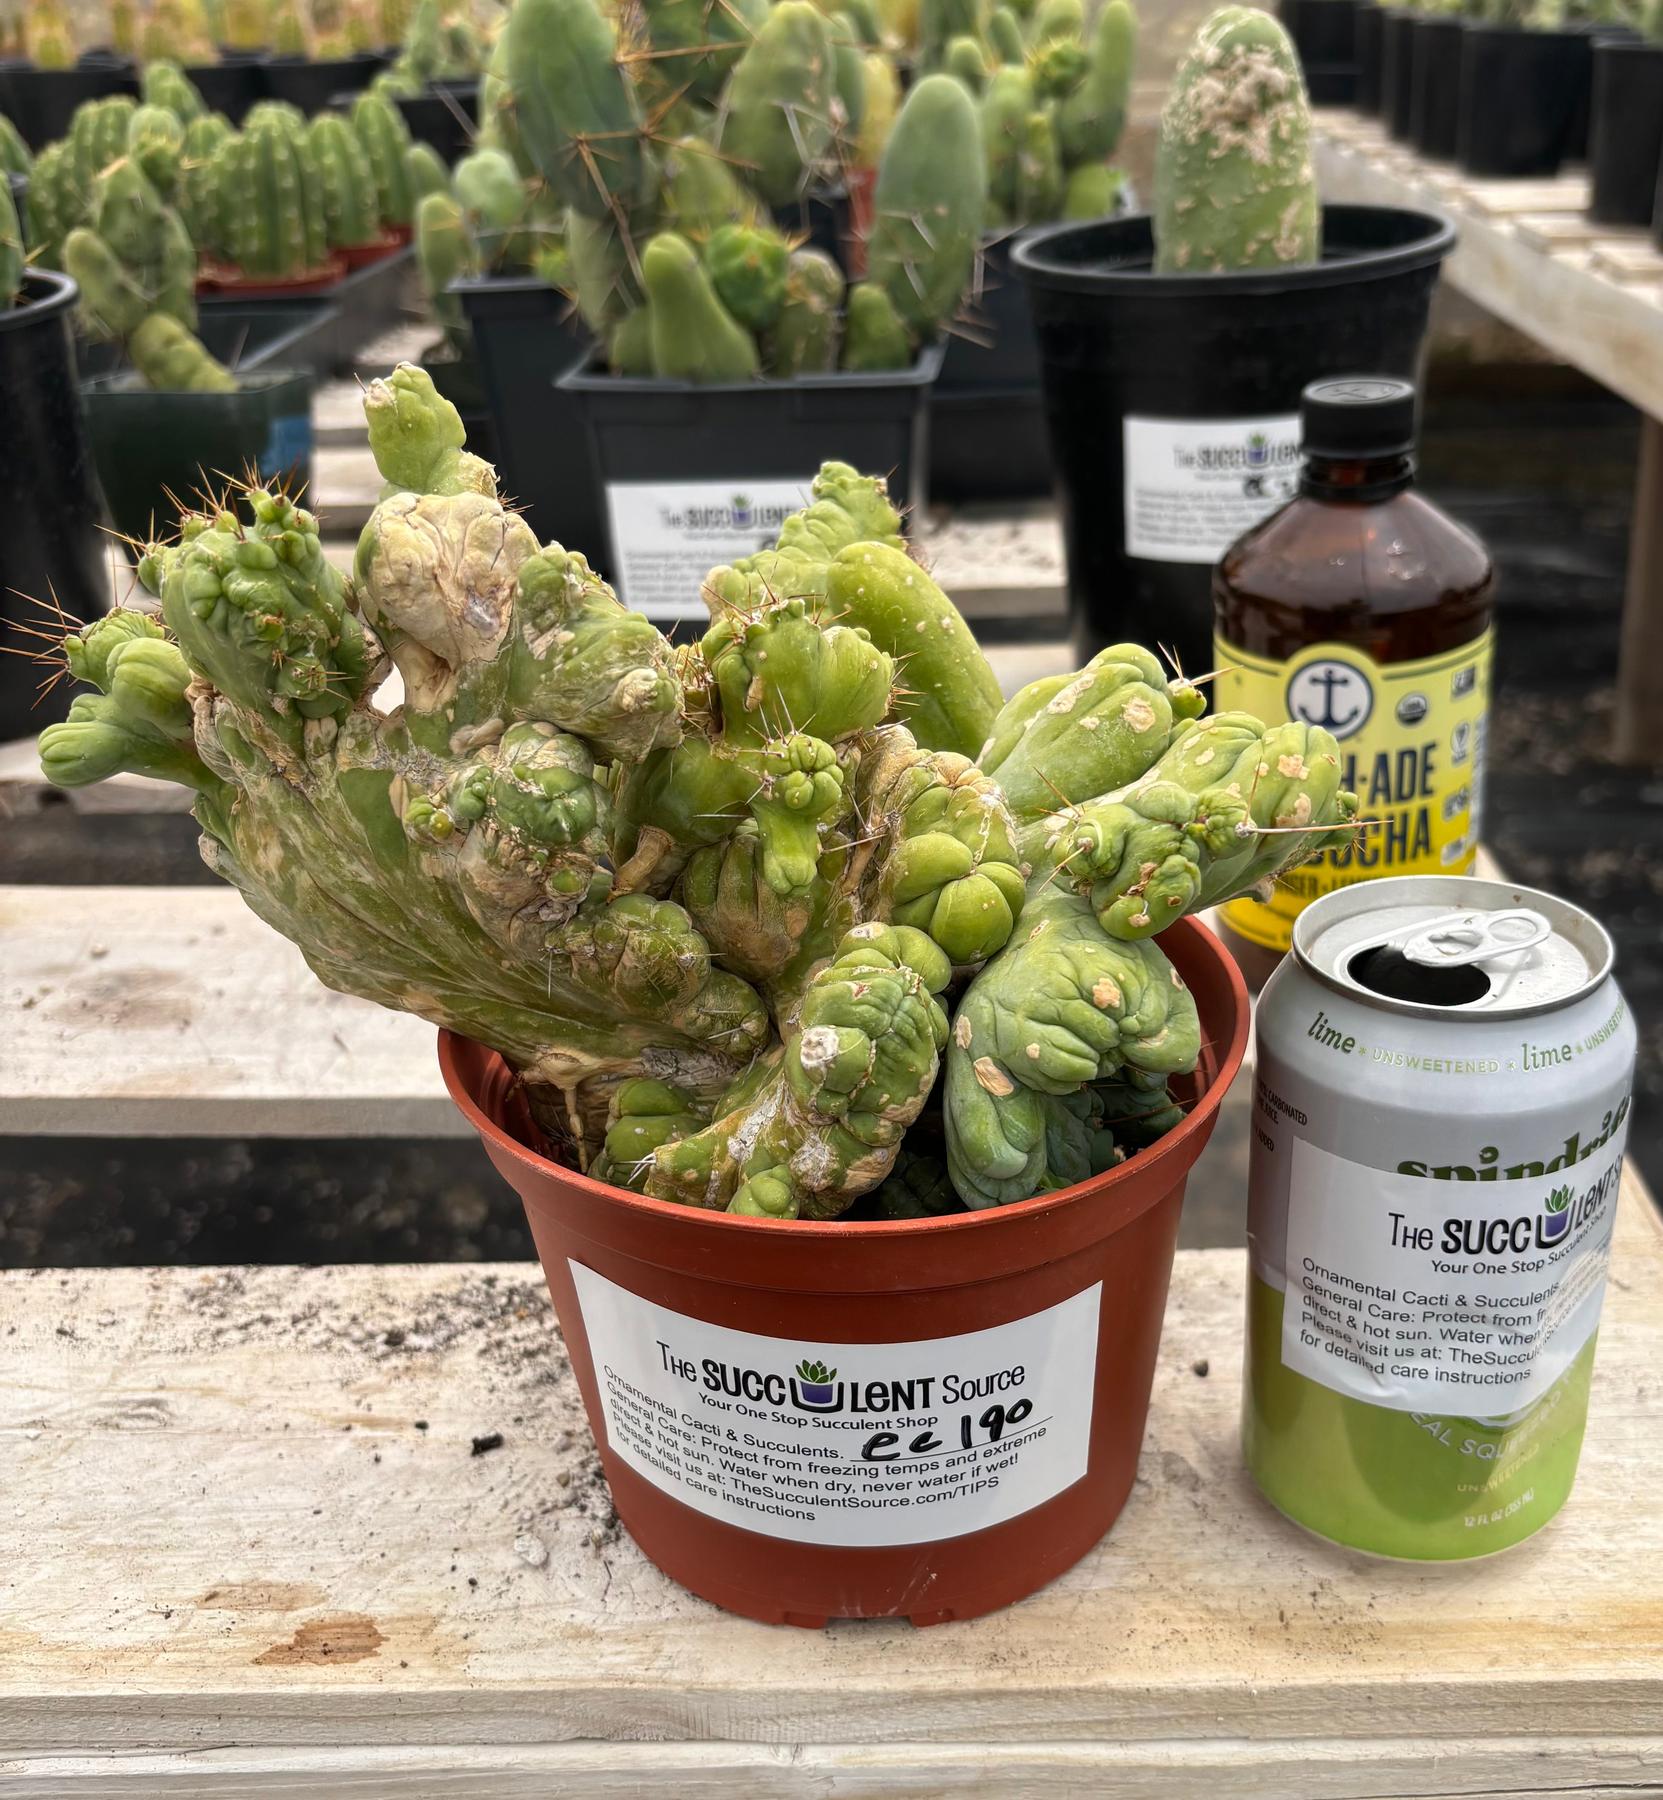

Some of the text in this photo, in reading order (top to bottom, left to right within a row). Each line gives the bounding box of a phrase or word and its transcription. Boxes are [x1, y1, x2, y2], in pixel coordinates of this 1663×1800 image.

[1307, 1012, 1356, 1054] lime
[1372, 1047, 1500, 1074] UNSWEETENED
[1521, 1043, 1573, 1071] lime
[1268, 1089, 1308, 1126] CARBONATED
[1302, 1257, 1396, 1302] Ornamental
[1402, 1290, 1449, 1307] Cacti
[1455, 1294, 1468, 1307] &
[1431, 1259, 1469, 1274] Your
[1473, 1262, 1507, 1275] One
[1511, 1258, 1545, 1274] Stop
[1302, 1276, 1362, 1312] General
[1368, 1303, 1416, 1323] Care:
[1422, 1311, 1486, 1325] Protect
[1493, 1313, 1532, 1327] from
[1303, 1294, 1541, 1345] direct & hot sun. Water when
[1300, 1328, 1531, 1386] for detailed care instructions
[1301, 1311, 1352, 1343] Please
[1356, 1340, 1389, 1357] visit
[1394, 1347, 1415, 1357] us
[1420, 1346, 1442, 1360] at:
[942, 1365, 1025, 1404] Source
[603, 1365, 844, 1459] Ornamental Cacti & Succulents.
[607, 1380, 1047, 1479] General Care: Protect from freezing temps and extreme
[698, 1392, 939, 1431] Your One Stop Succulent Shop
[960, 1398, 1034, 1449] 190
[610, 1397, 1019, 1495] direct & hot sun. Water when dry, never water if wet!
[613, 1411, 1000, 1509] Please visit us at: TheSucculentSource.com/TIPS
[616, 1426, 816, 1521] for detailed care instructions
[1464, 1516, 1476, 1527] 12
[1477, 1515, 1489, 1526] FL
